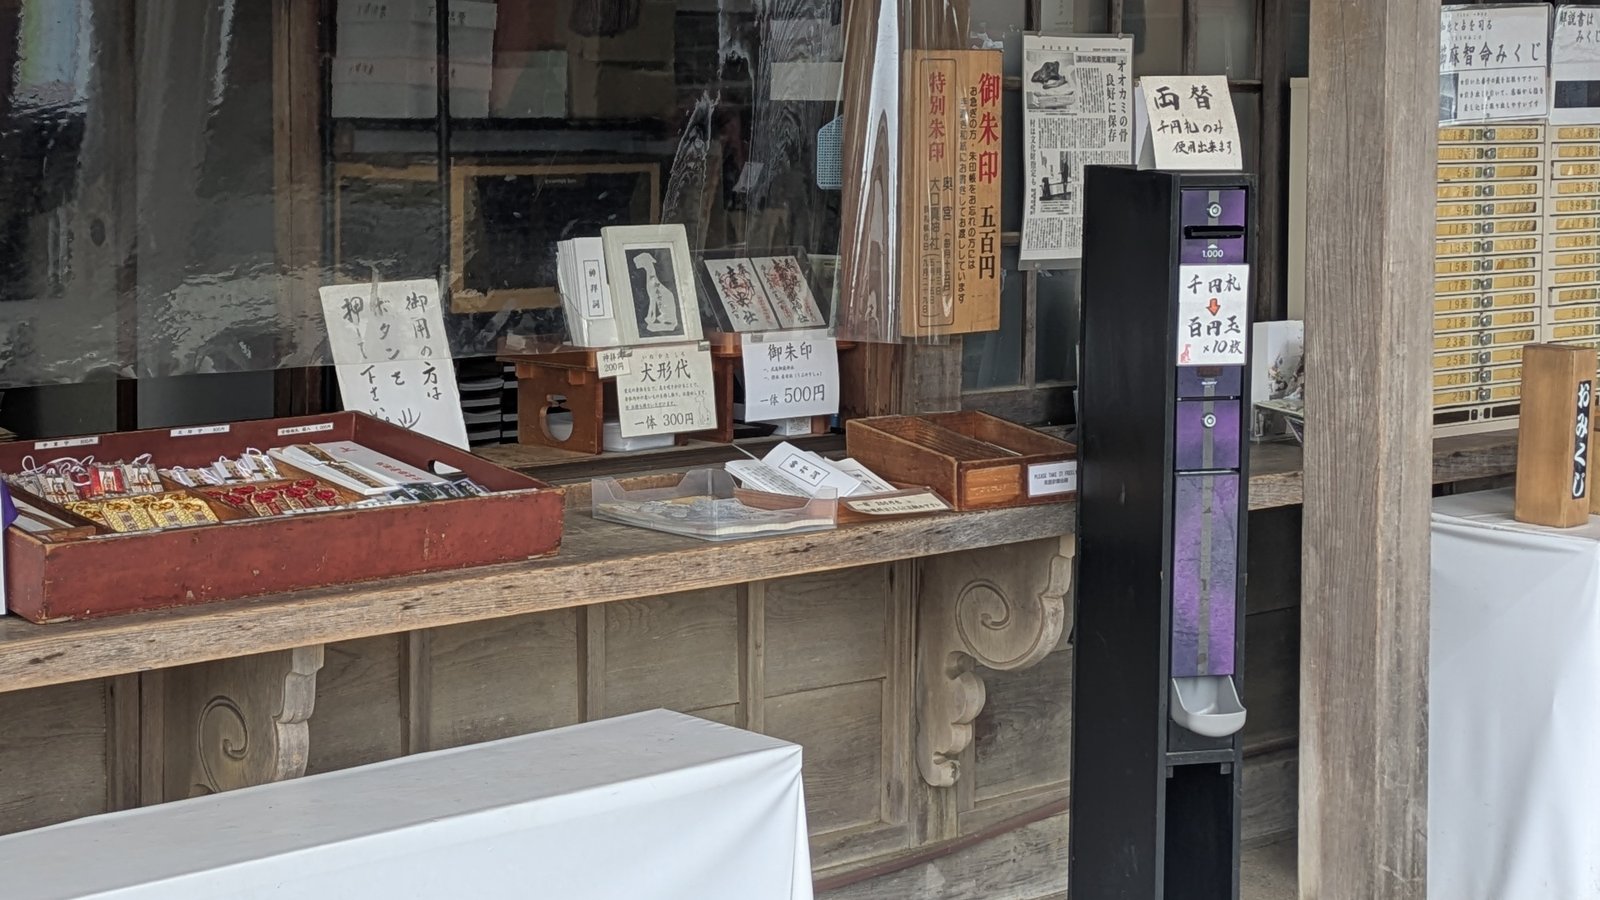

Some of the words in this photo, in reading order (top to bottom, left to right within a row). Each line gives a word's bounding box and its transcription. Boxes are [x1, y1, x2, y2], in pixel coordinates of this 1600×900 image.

[1106, 73, 1117, 142] 良好に保存
[1117, 60, 1128, 143] オオカミの骨
[1154, 84, 1212, 111] 両替
[928, 71, 946, 163] 特別朱印
[978, 72, 1001, 184] 御朱印
[1157, 119, 1223, 134] 千円札のみ
[1172, 140, 1232, 155] 使用出来ます
[979, 205, 996, 279] 五百円
[1187, 274, 1241, 294] 千円札
[1188, 315, 1241, 338] 百円玉
[373, 297, 405, 386] ボタンを
[405, 292, 442, 401] 御用の方は
[768, 341, 812, 362] 御朱印
[604, 362, 625, 373] 200円
[641, 358, 691, 382] 犬形代
[760, 394, 779, 406] 一体
[784, 384, 825, 403] 500円
[634, 415, 658, 430] 一体
[663, 412, 694, 427] 300円
[1572, 383, 1590, 498] おみくじ
